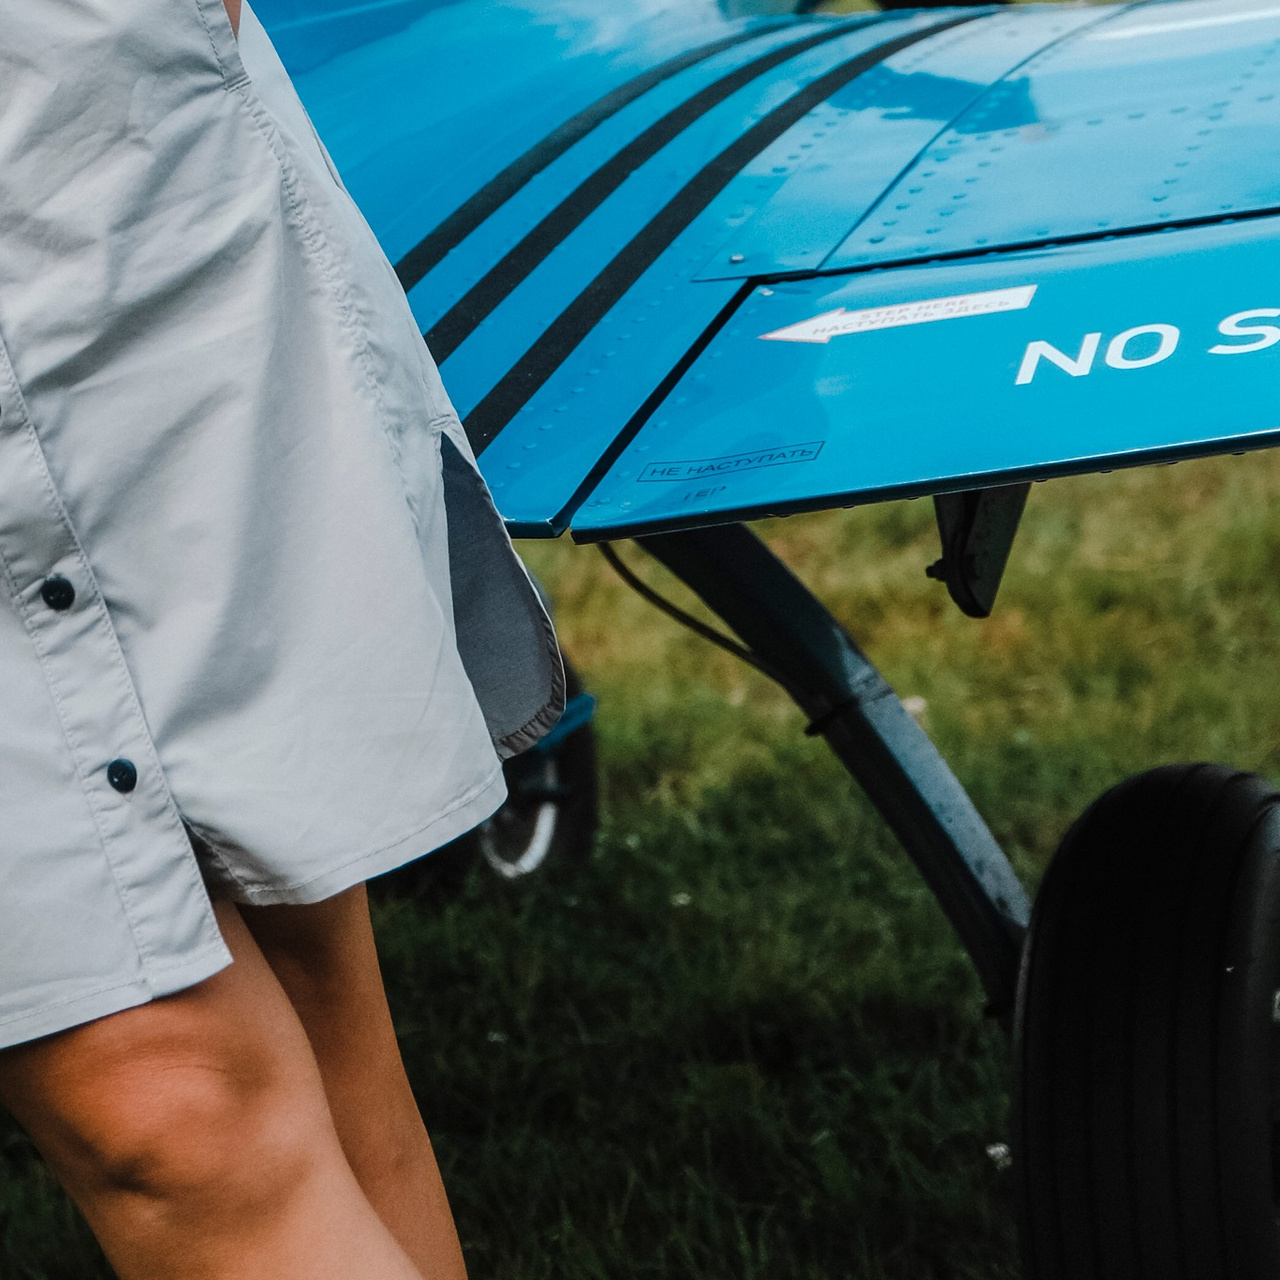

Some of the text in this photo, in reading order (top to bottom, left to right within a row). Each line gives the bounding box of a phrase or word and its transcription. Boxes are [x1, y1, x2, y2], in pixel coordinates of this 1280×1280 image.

[813, 301, 1010, 335] НАСТУПАТЬ ЗДЕСЬ
[861, 298, 970, 320] STEP HERE
[1015, 308, 1280, 385] NO S
[650, 448, 815, 476] НЕ НАСТУПАТЬ
